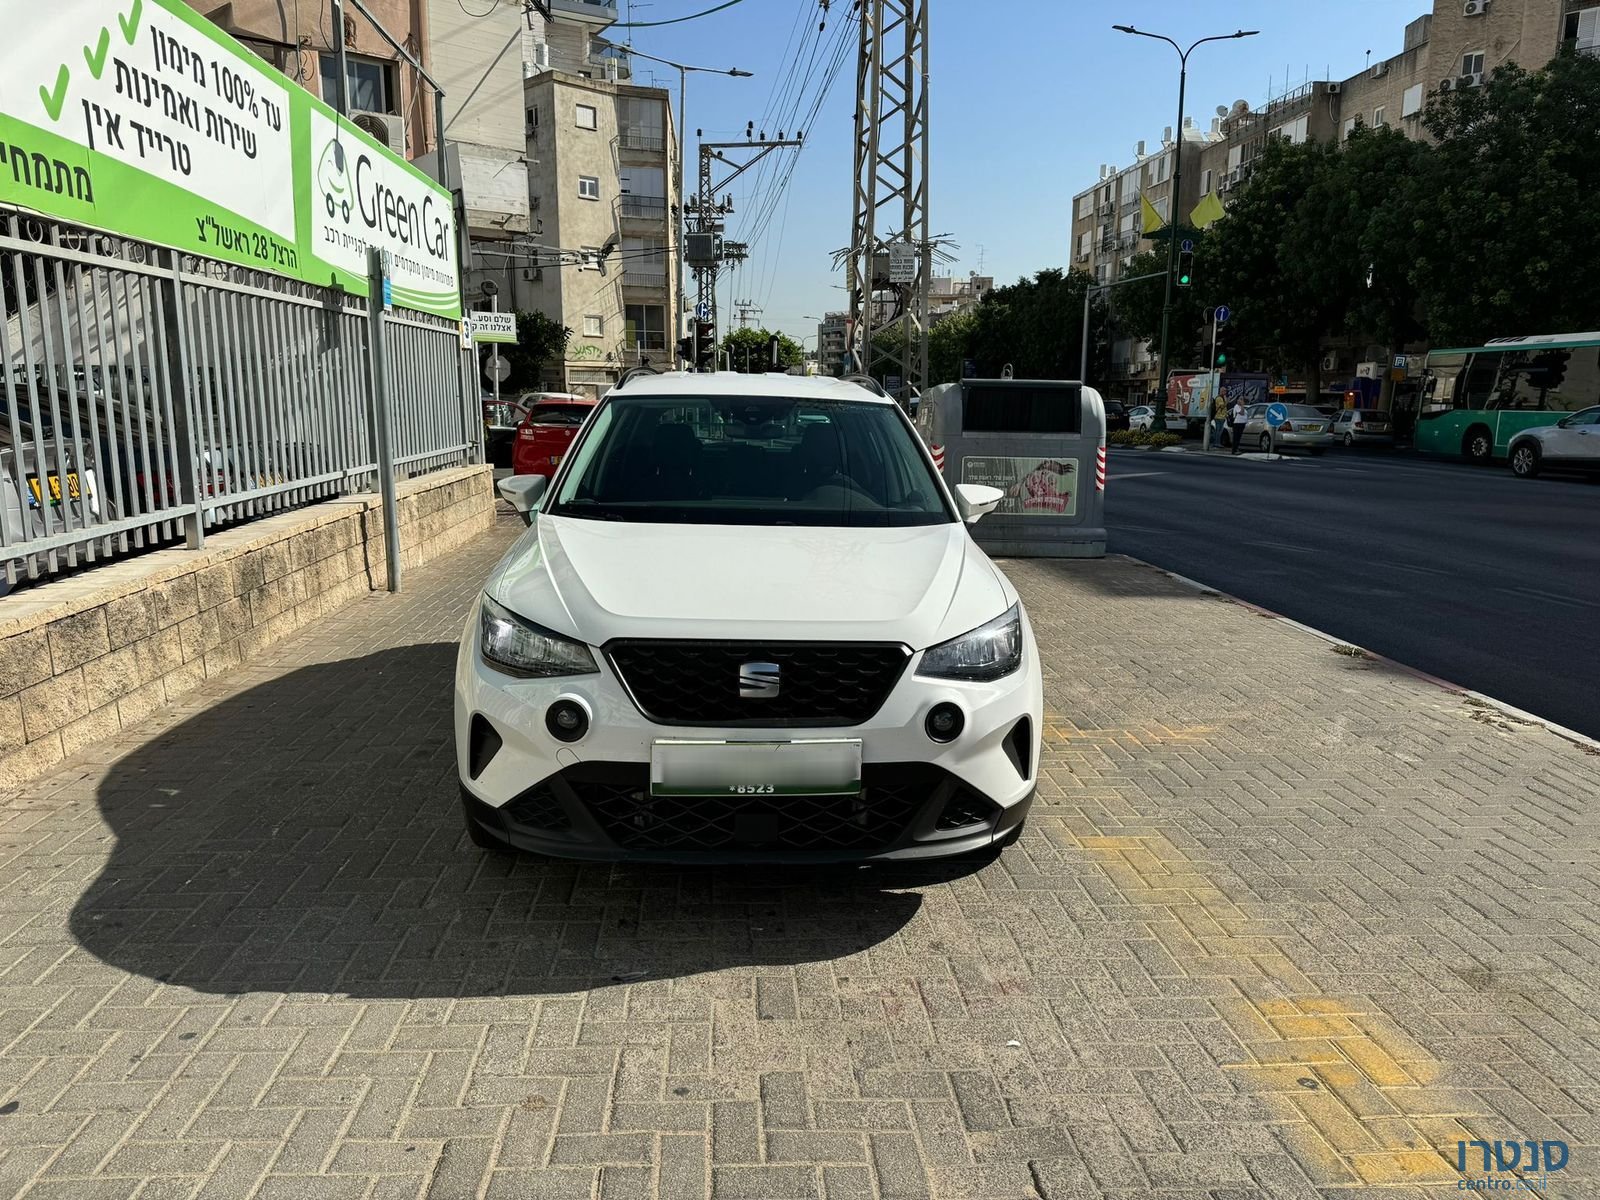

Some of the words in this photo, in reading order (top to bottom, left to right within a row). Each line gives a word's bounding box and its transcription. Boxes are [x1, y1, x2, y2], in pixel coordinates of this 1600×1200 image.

[150, 25, 206, 88] מימון
[113, 57, 200, 132] ואמינות
[211, 61, 258, 119] 100%
[261, 96, 281, 131] עד
[82, 98, 125, 151] אין
[130, 120, 191, 176] טרייד
[205, 107, 257, 159] שירות
[356, 154, 420, 249] Green
[423, 195, 449, 261] Car
[253, 232, 269, 260] 28
[270, 237, 298, 269] הרצל
[324, 225, 341, 246] רכב
[490, 324, 512, 332] אצלנו
[494, 315, 511, 324] שלם
